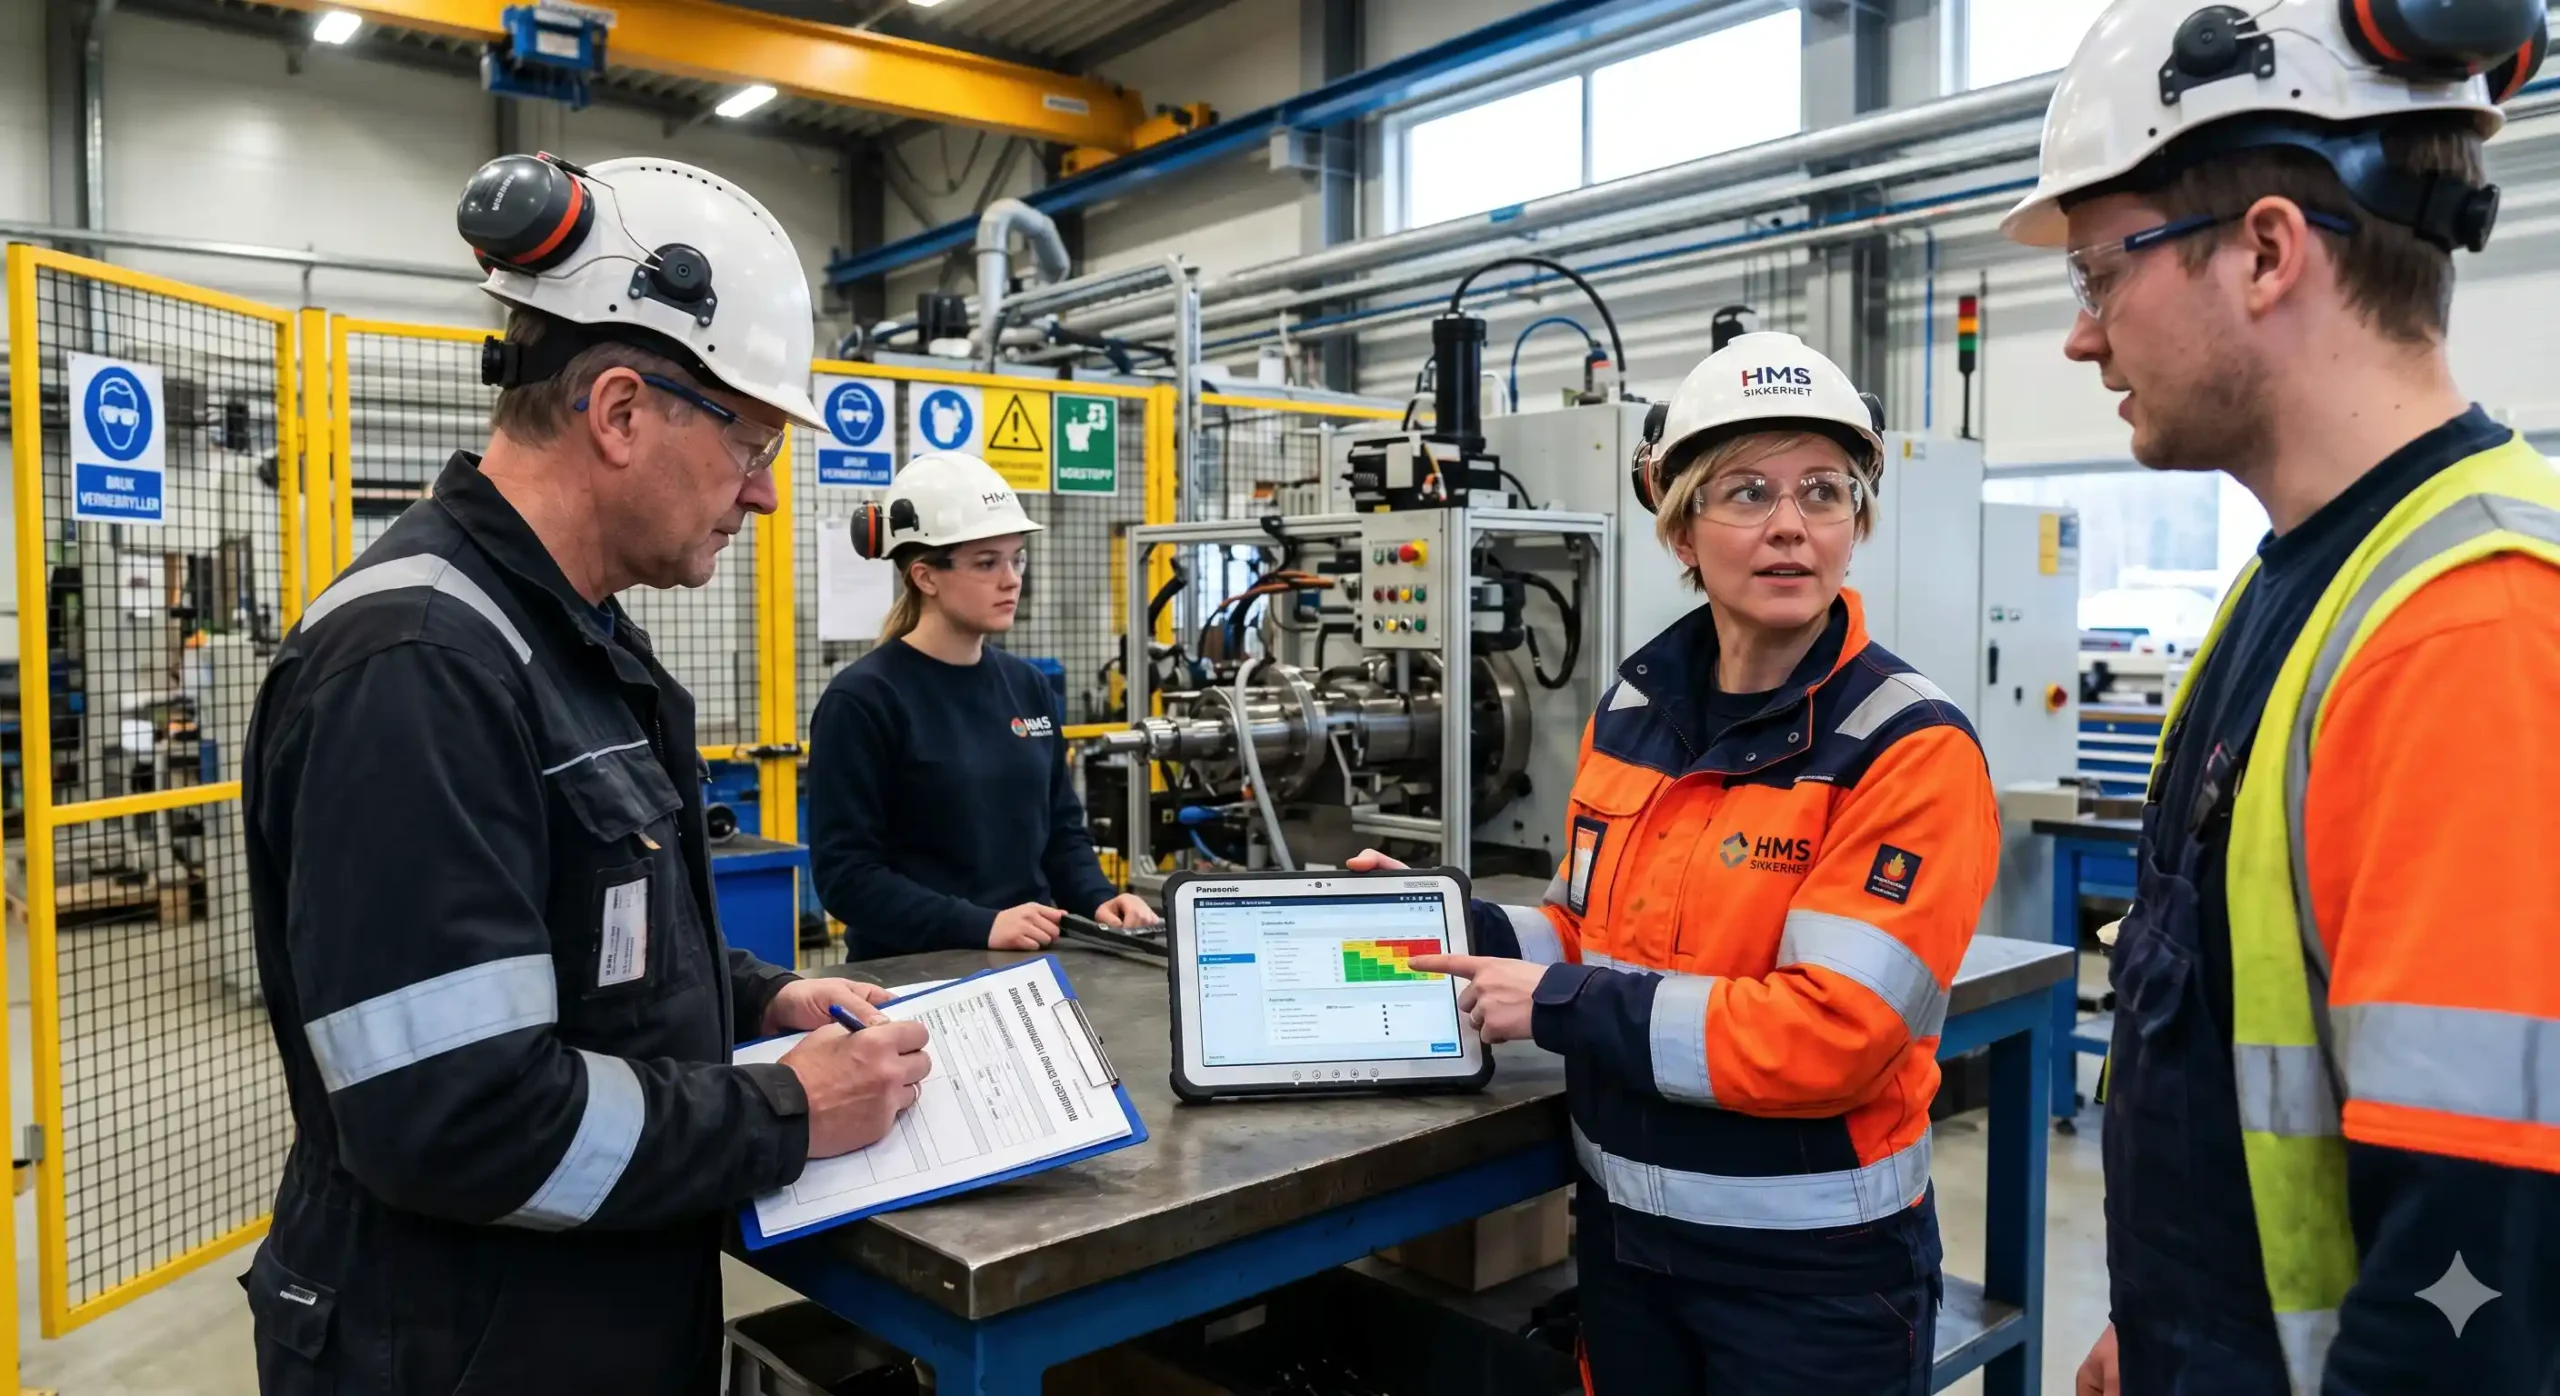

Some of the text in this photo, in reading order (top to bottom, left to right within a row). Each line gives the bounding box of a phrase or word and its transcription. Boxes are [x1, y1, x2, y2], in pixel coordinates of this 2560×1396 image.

[1742, 366, 1812, 387] HMS
[1743, 386, 1813, 398] SIKKERHET
[1753, 835, 1811, 862] HMS
[1195, 885, 1240, 894] Panasonic
